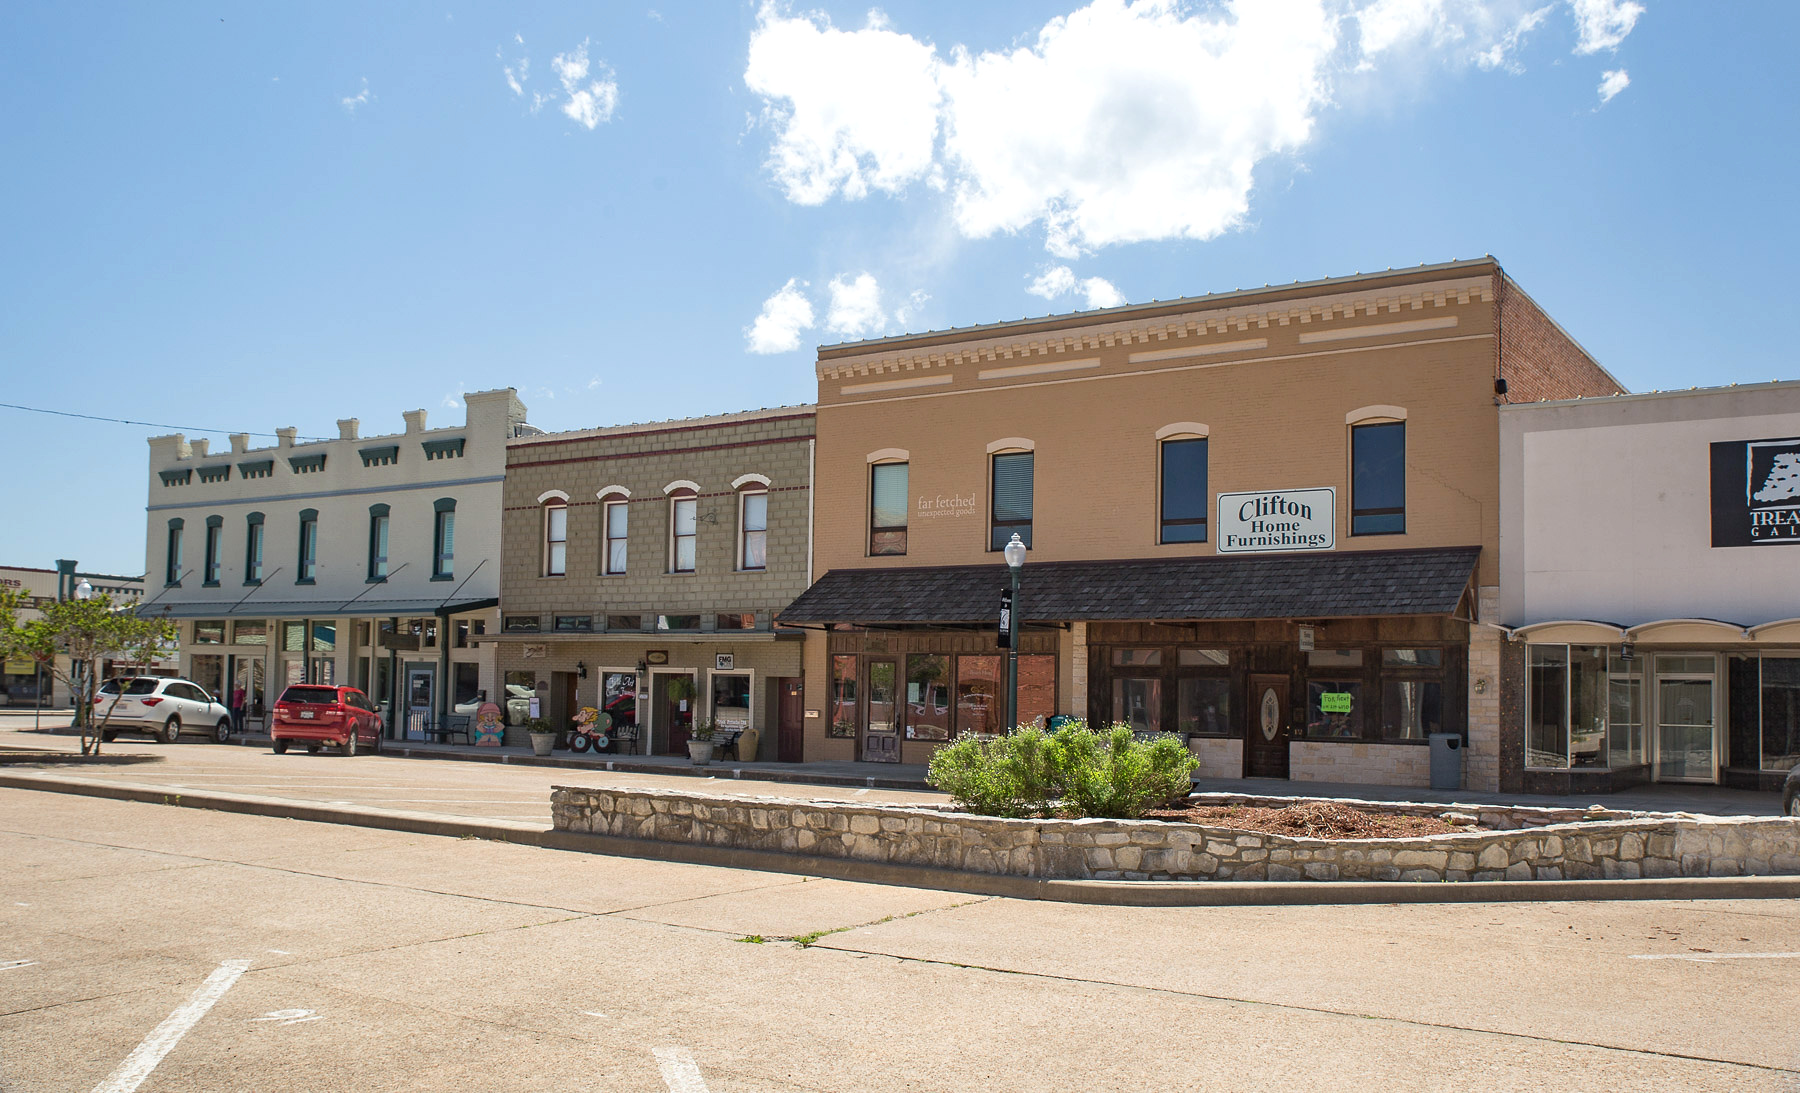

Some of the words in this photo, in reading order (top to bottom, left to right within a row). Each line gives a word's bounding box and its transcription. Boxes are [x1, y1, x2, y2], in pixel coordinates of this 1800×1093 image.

[918, 496, 933, 509] far
[936, 493, 976, 507] fetched
[1239, 495, 1312, 522] Clifton
[918, 509, 954, 519] unexpected
[956, 506, 976, 518] goods
[1750, 511, 1800, 526] TREA
[1251, 520, 1301, 533] Home
[1751, 526, 1797, 537] GAL
[1226, 532, 1326, 547] Furnishings
